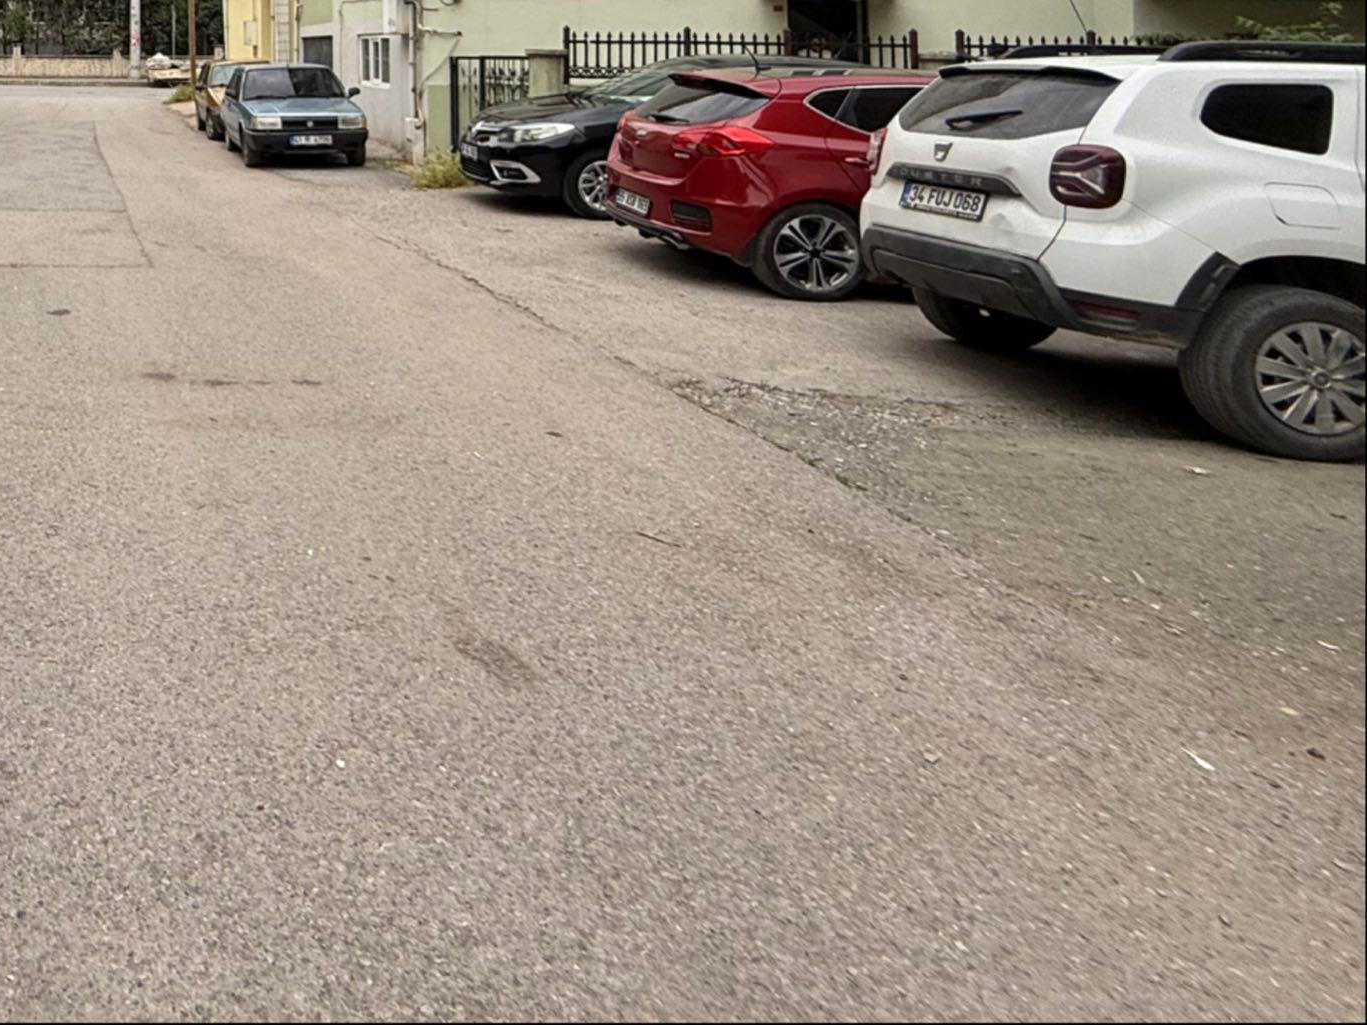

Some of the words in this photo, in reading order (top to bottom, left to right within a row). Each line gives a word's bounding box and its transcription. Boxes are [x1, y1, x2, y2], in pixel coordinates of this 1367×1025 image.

[909, 185, 926, 203] 34
[927, 189, 953, 208] FUJ
[953, 193, 982, 212] 068
